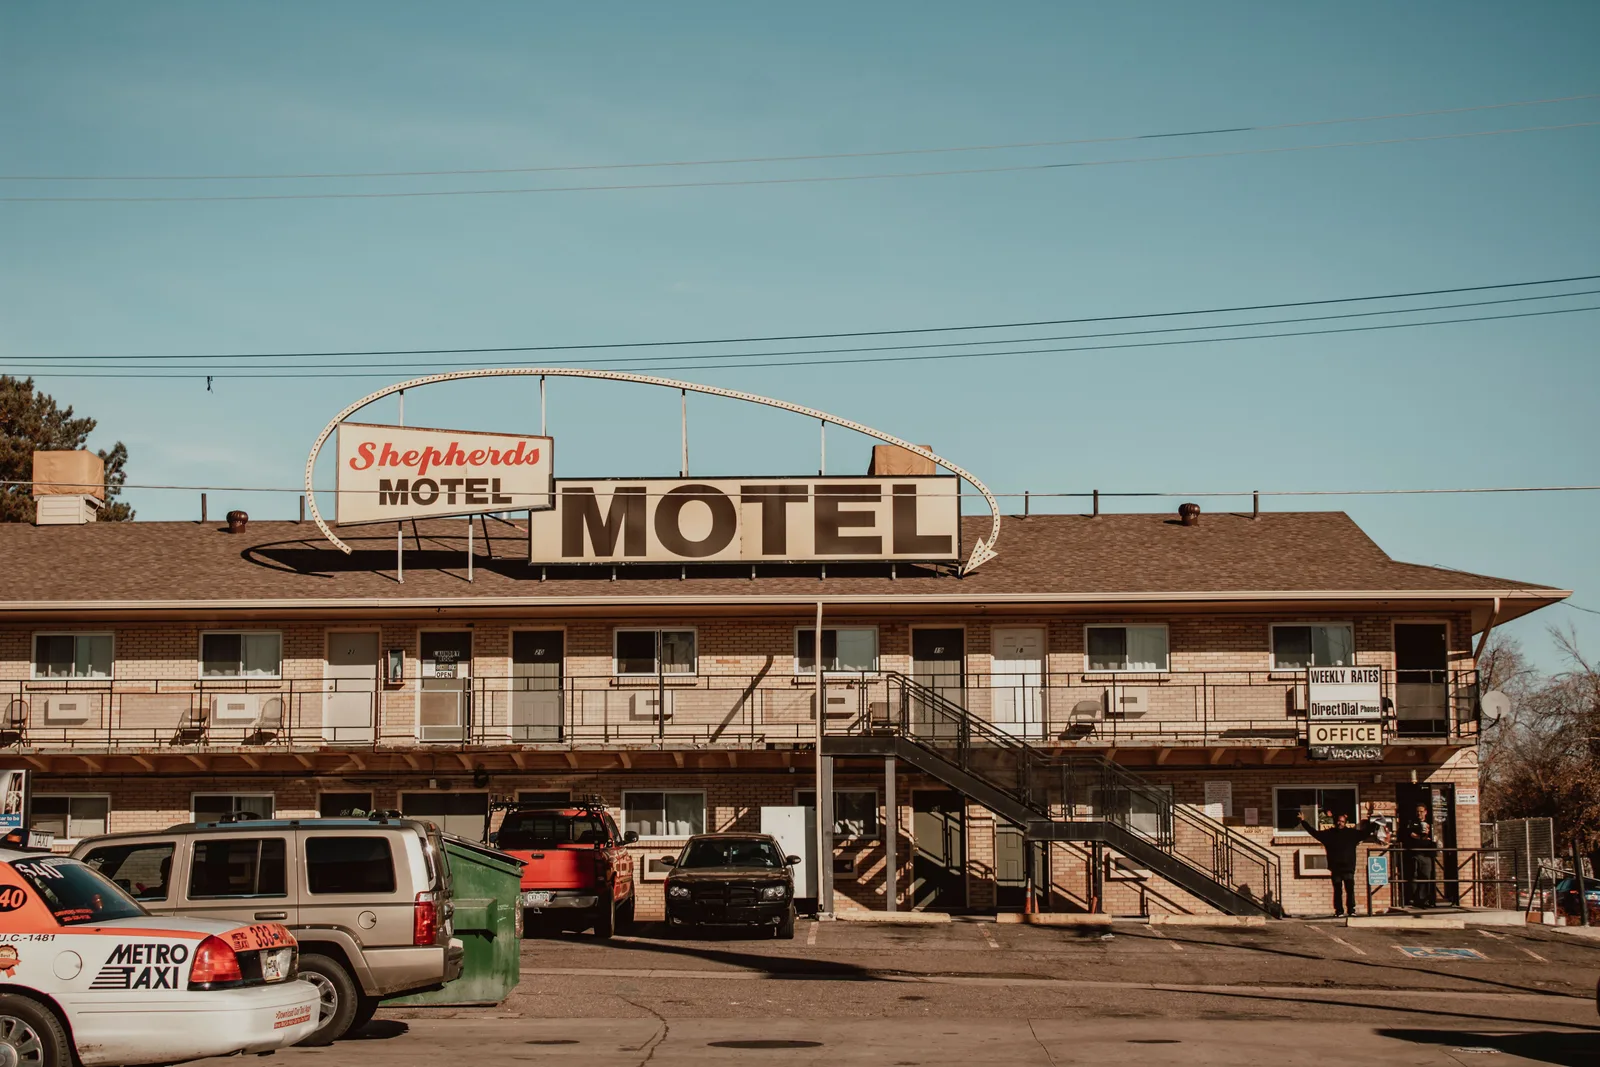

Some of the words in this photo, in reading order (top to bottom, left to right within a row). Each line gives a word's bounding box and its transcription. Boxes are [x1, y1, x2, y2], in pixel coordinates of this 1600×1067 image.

[349, 441, 540, 476] Shepherds
[379, 478, 512, 506] MOTEL
[562, 484, 952, 558] MOTEL
[1311, 670, 1346, 684] WEEKLY
[1351, 670, 1379, 683] RATES
[1360, 705, 1380, 713] Phones
[1316, 728, 1376, 742] OFFICE
[1331, 749, 1381, 760] VACANCY
[34, 833, 50, 847] TAXI
[105, 944, 188, 965] METRO
[96, 967, 179, 990] TAXI
